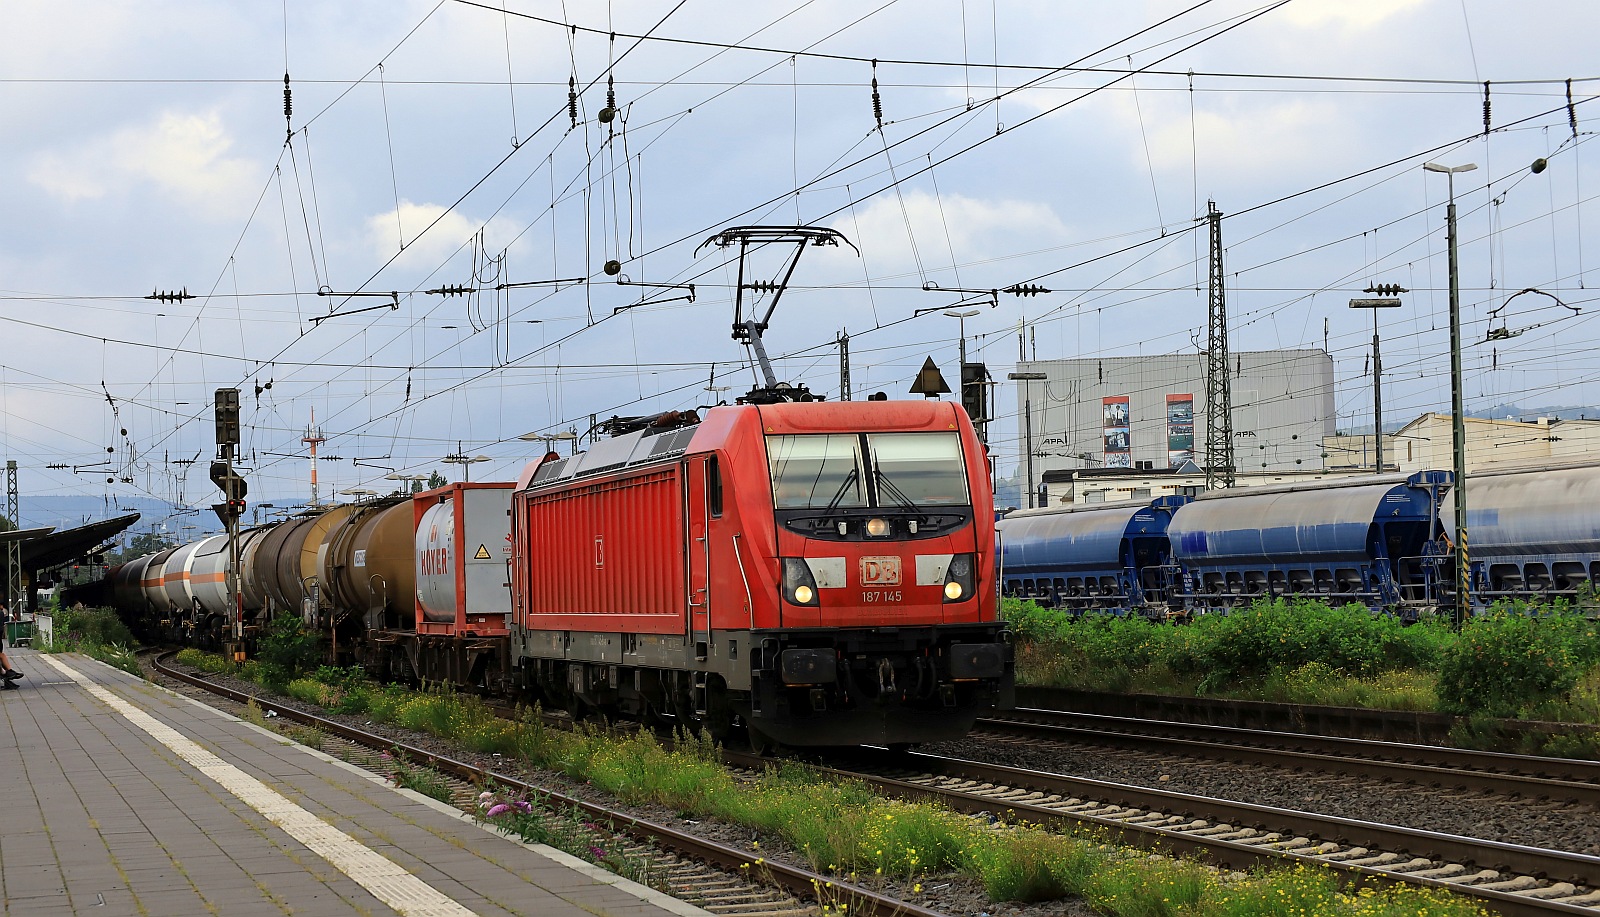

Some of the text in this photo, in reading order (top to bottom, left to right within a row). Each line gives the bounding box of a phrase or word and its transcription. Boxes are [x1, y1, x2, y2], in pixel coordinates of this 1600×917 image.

[421, 548, 448, 576] HOYER
[865, 560, 897, 582] DB
[862, 590, 902, 602] 187 145
